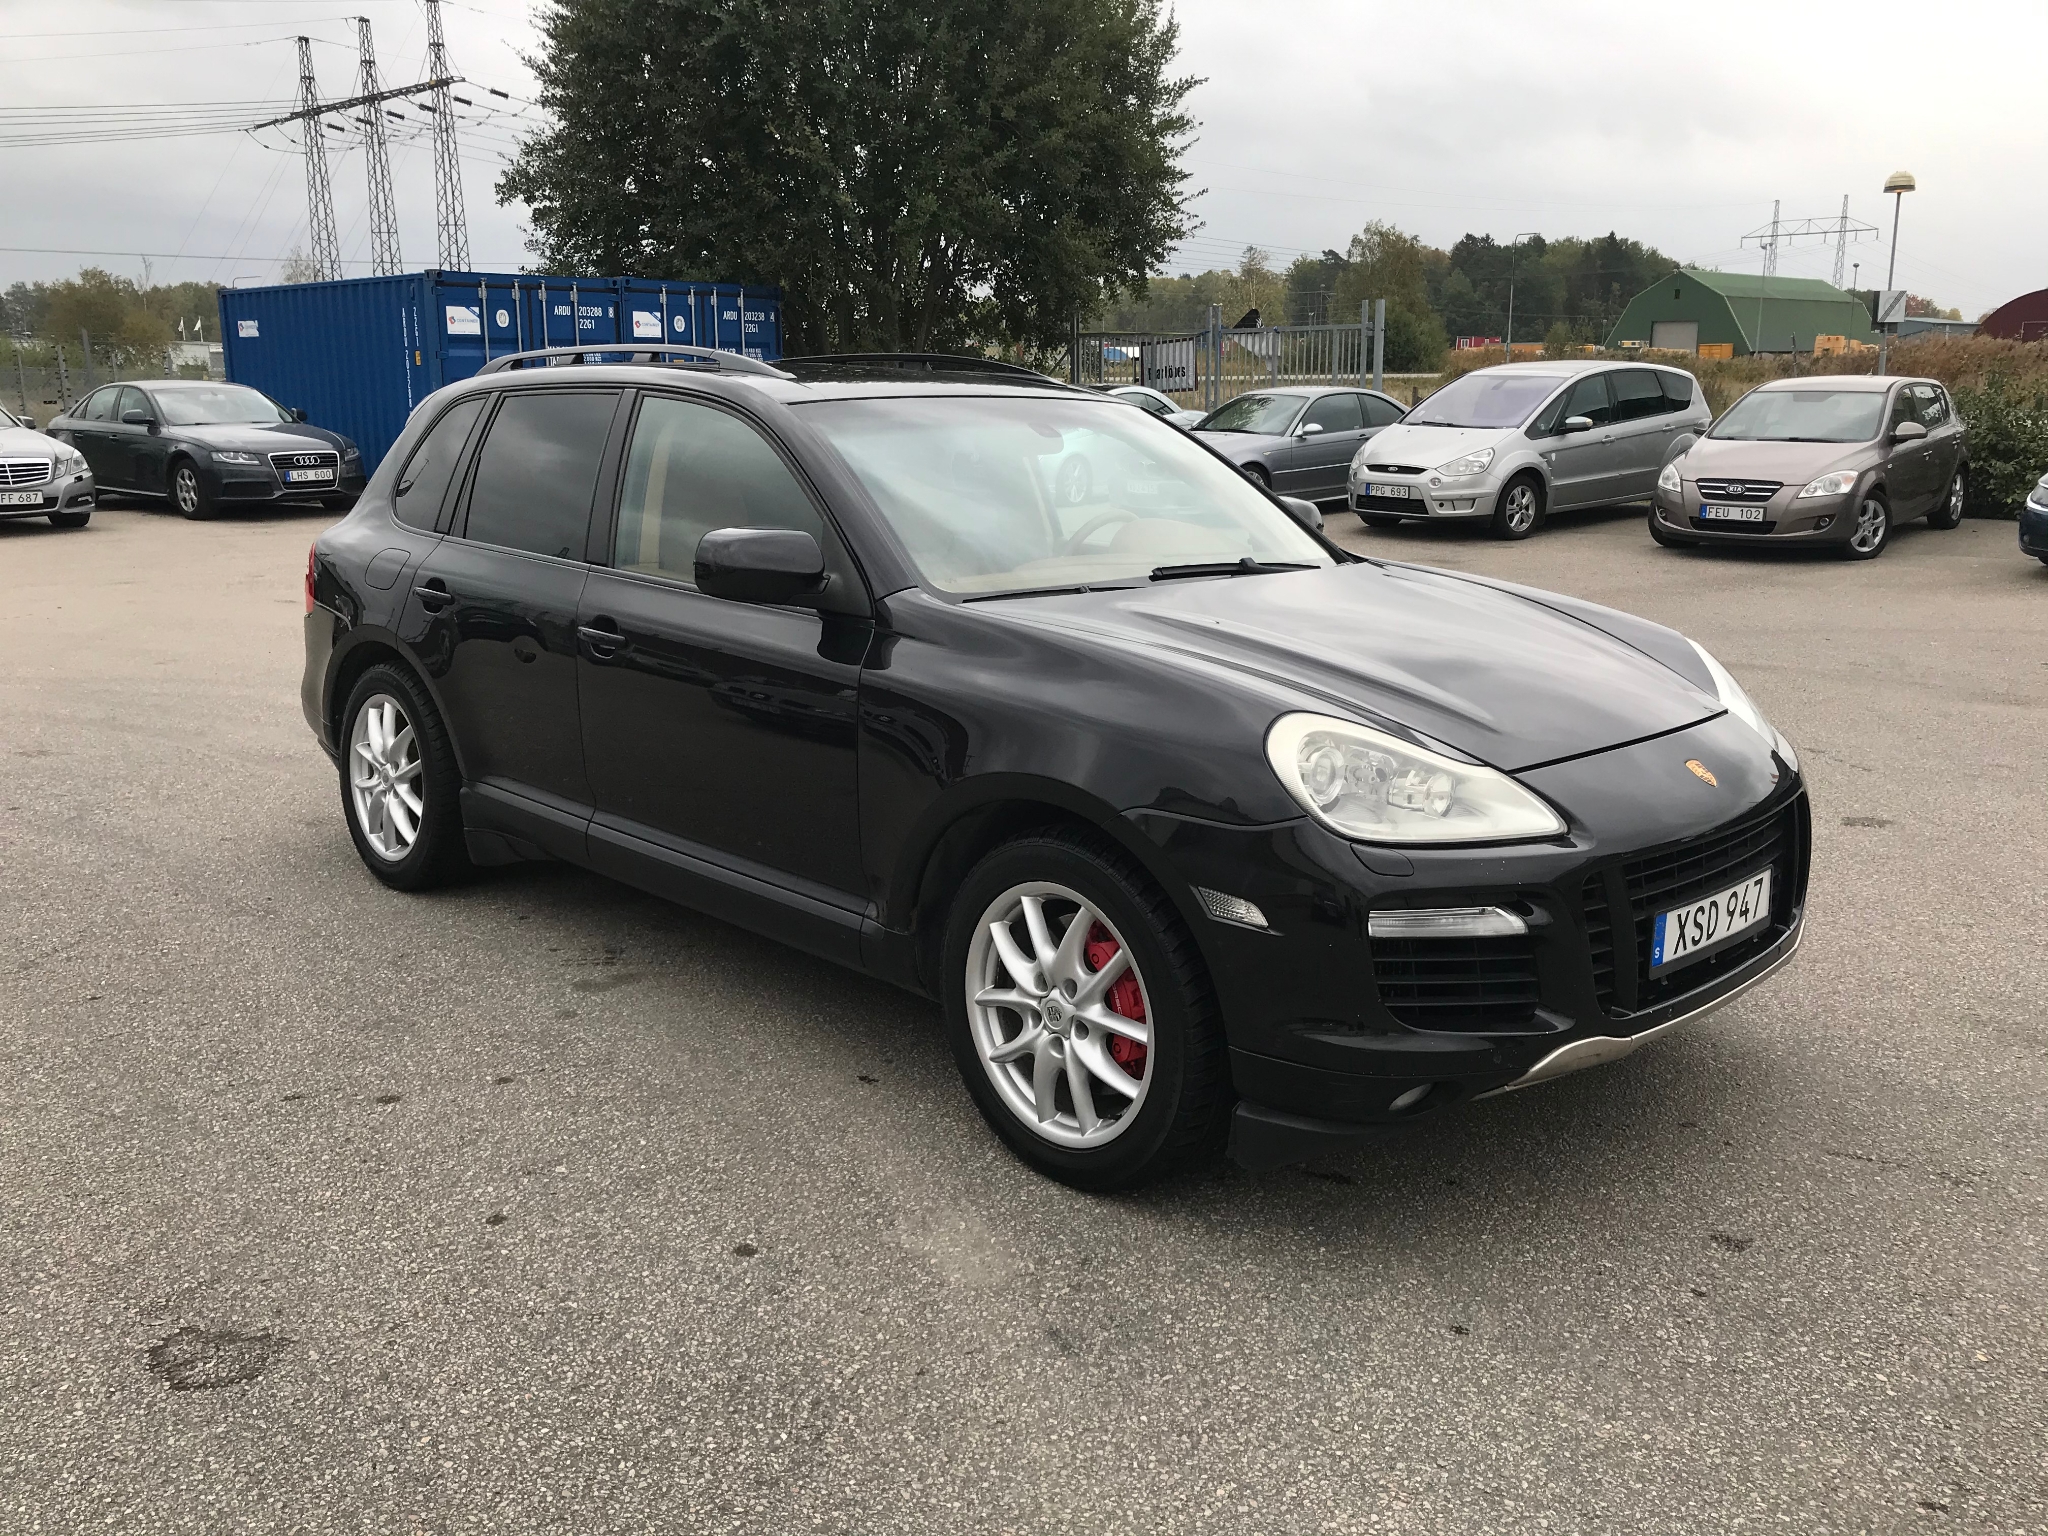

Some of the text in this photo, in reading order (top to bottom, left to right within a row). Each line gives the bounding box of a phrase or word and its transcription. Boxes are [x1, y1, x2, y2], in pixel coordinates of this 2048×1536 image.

[554, 305, 571, 316] ARDU
[578, 306, 603, 317] 203288
[722, 310, 738, 321] ARDU
[744, 311, 765, 322] 203238
[291, 470, 331, 480] LHS 600
[1371, 485, 1407, 497] PPG 693
[0, 493, 39, 503] FF 687
[1708, 506, 1761, 520] FEU 102
[1673, 876, 1764, 955] XSD 947
